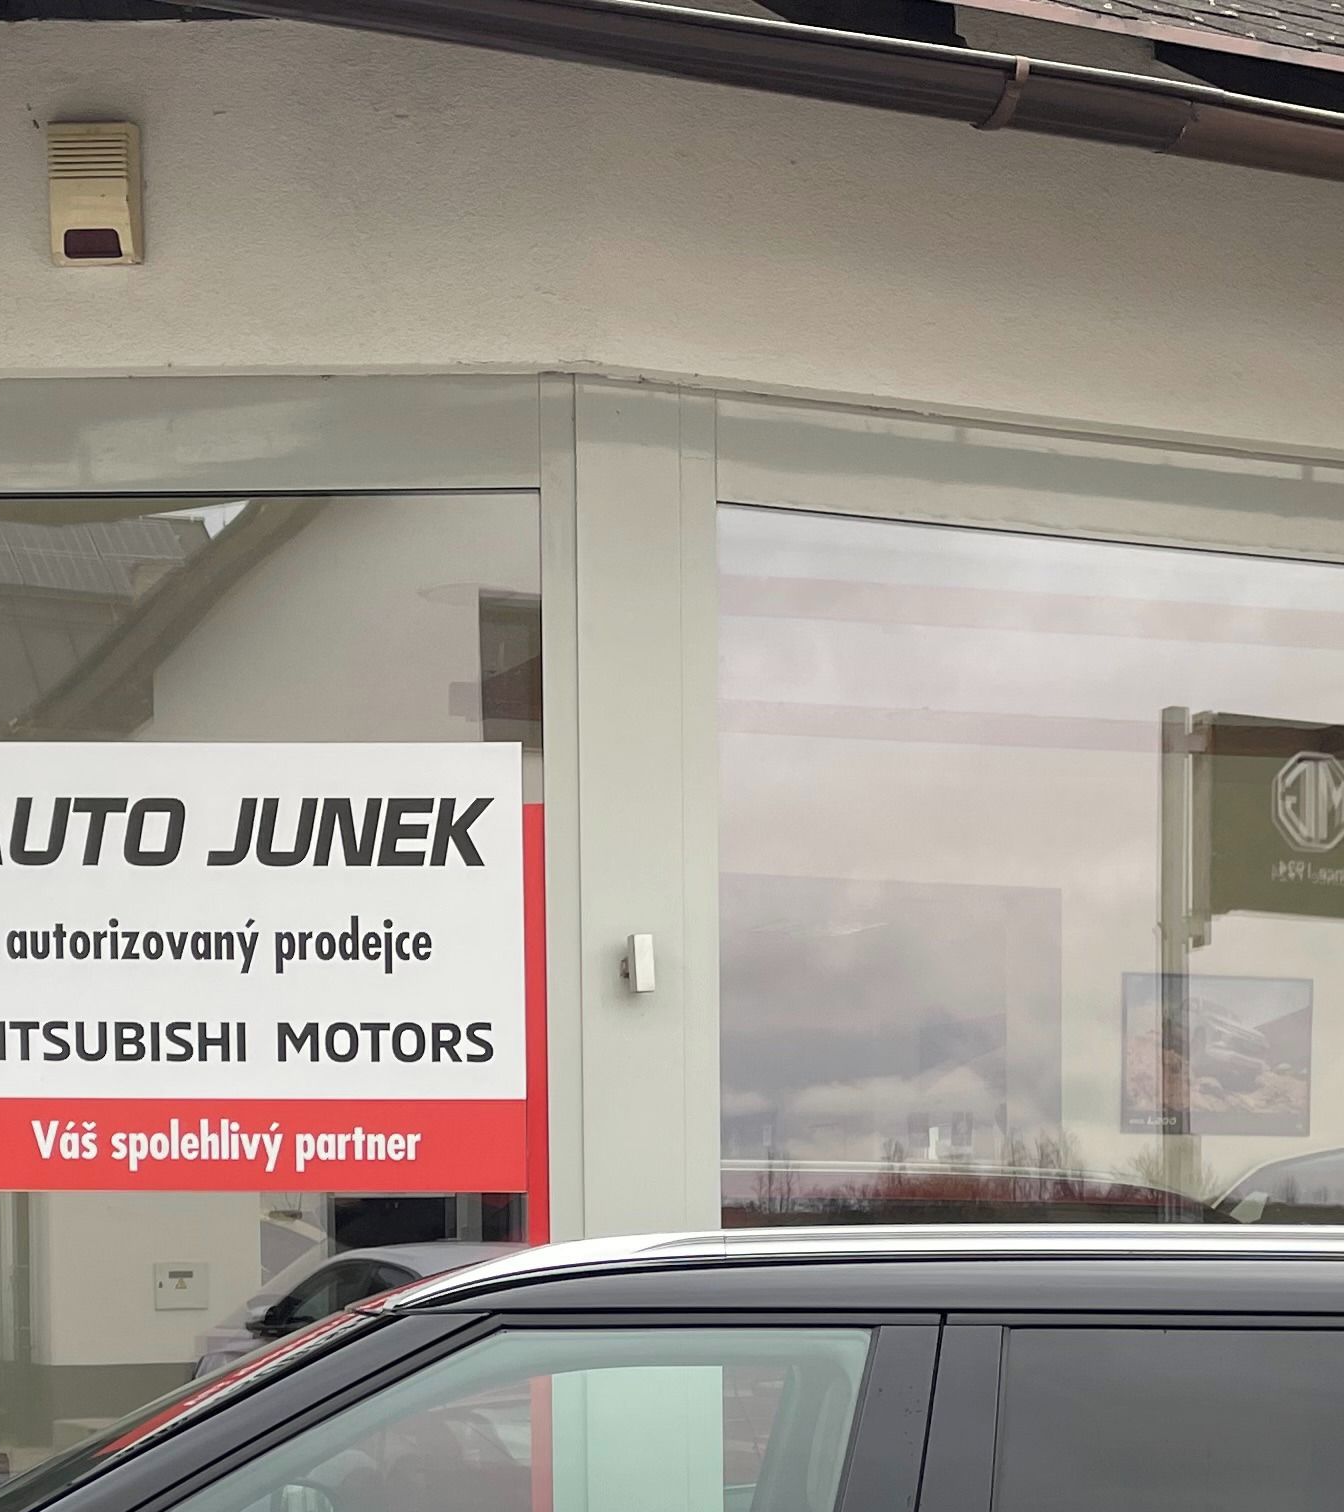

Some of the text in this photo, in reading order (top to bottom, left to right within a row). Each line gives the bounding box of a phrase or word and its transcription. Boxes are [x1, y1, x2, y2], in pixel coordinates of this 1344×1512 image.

[206, 797, 495, 867] JUNEK
[6, 917, 433, 975] autorizovaný prodejce
[277, 1021, 495, 1064] MOTORS
[31, 1117, 421, 1173] Váš spolehlivý partner
